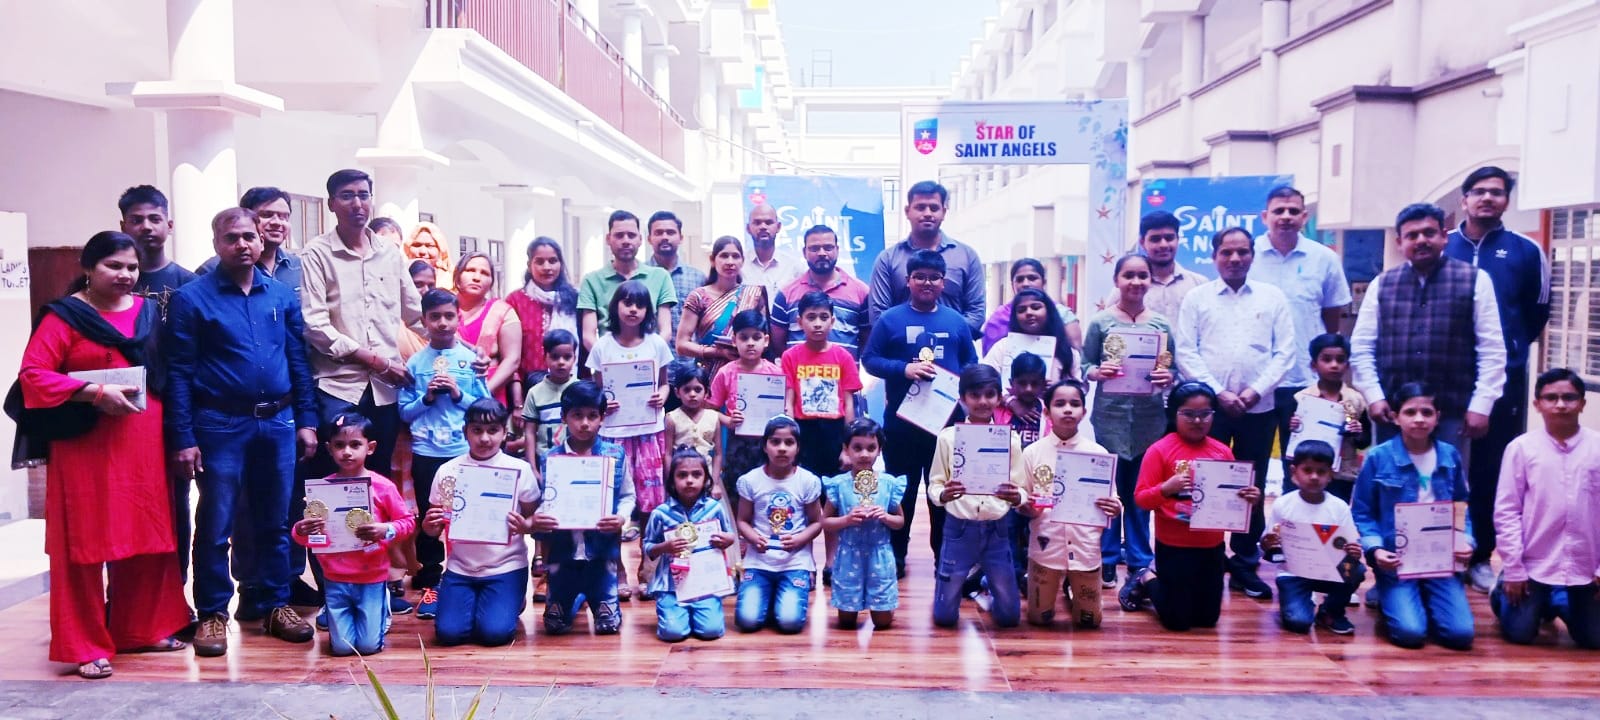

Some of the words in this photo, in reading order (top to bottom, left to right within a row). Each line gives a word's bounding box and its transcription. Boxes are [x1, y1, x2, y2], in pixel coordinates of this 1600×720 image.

[976, 124, 1013, 140] STAR
[1018, 125, 1035, 139] OF
[955, 143, 998, 157] SAINT
[1001, 142, 1057, 157] ANGELS
[797, 365, 841, 379] SPEED
